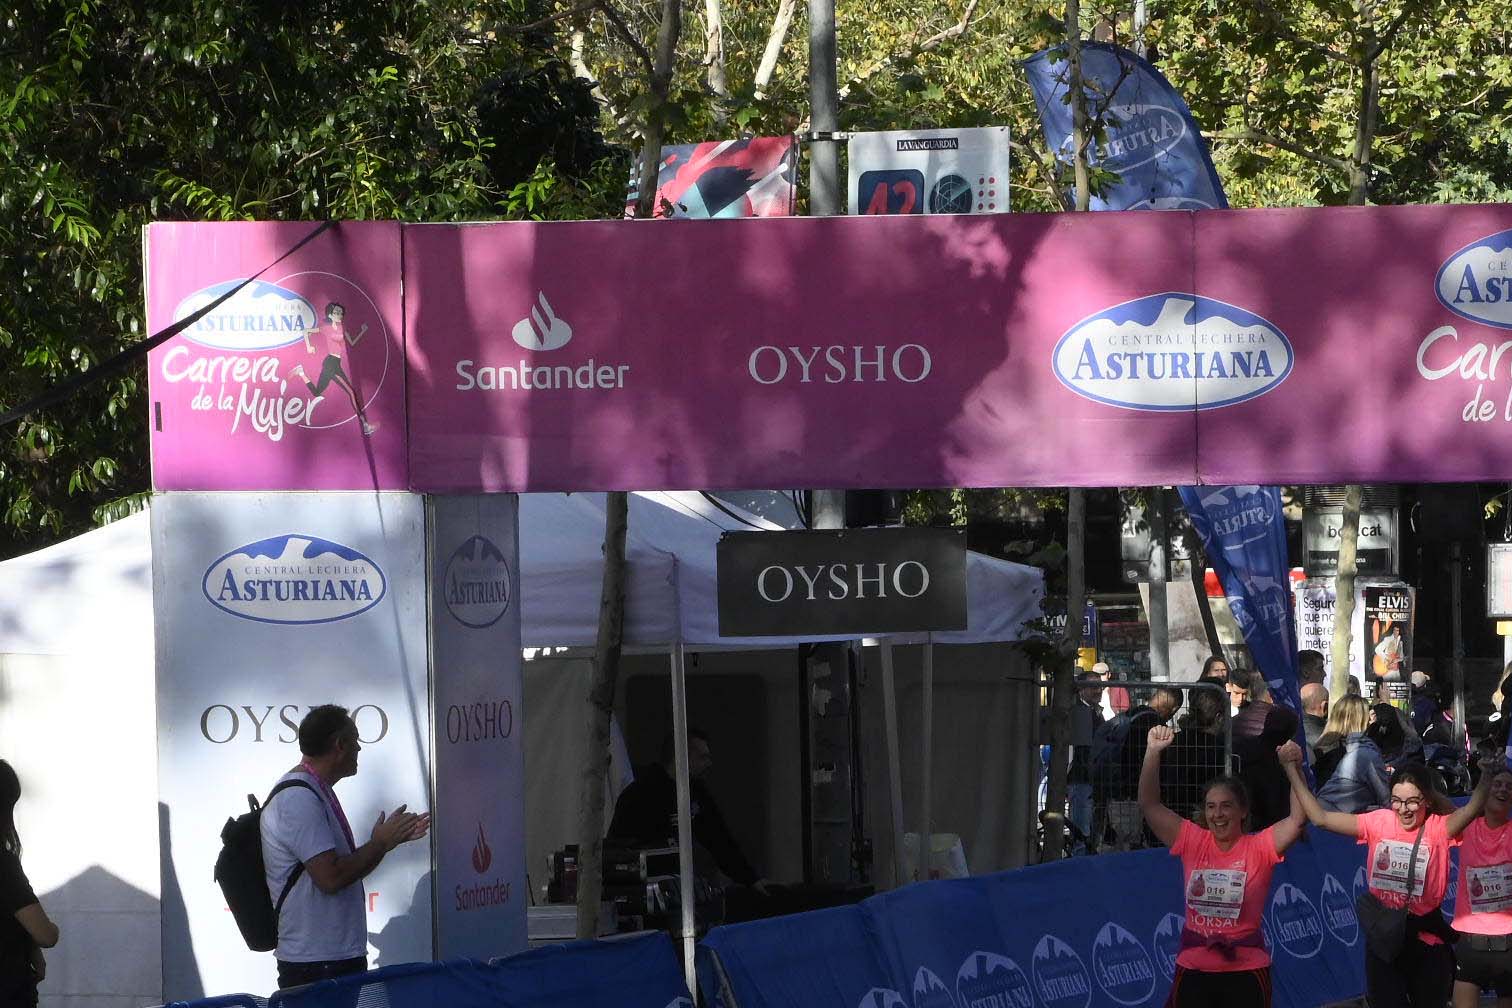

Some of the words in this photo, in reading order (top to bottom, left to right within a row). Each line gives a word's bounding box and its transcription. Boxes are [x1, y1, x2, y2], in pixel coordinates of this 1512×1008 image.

[1108, 333, 1183, 345] CENTRAL
[1190, 332, 1267, 345] LECHERA
[162, 345, 280, 384] Carrera
[456, 359, 630, 391] Santander
[748, 343, 932, 385] OYSHO
[1072, 337, 1274, 381] ASTURIANA
[191, 385, 213, 410] de
[217, 384, 233, 410] la
[230, 380, 325, 442] Mujer
[1462, 383, 1497, 423] de
[217, 567, 374, 602] ASTURIANA
[244, 565, 304, 575] CENTRAL
[308, 565, 367, 574] LECHERA
[757, 560, 931, 602] OYSHO
[448, 572, 507, 605] ASTURIANA
[1378, 596, 1409, 609] ELVIS
[1304, 613, 1320, 625] que
[200, 703, 390, 744] OYSO
[446, 700, 512, 744] OYSHO
[1391, 861, 1409, 870] 016
[455, 878, 511, 911] Santander
[1206, 886, 1225, 895] 016
[1484, 882, 1502, 891] 016
[1037, 969, 1090, 1001] ASTURIANA
[1099, 957, 1153, 988] ASTURIANA
